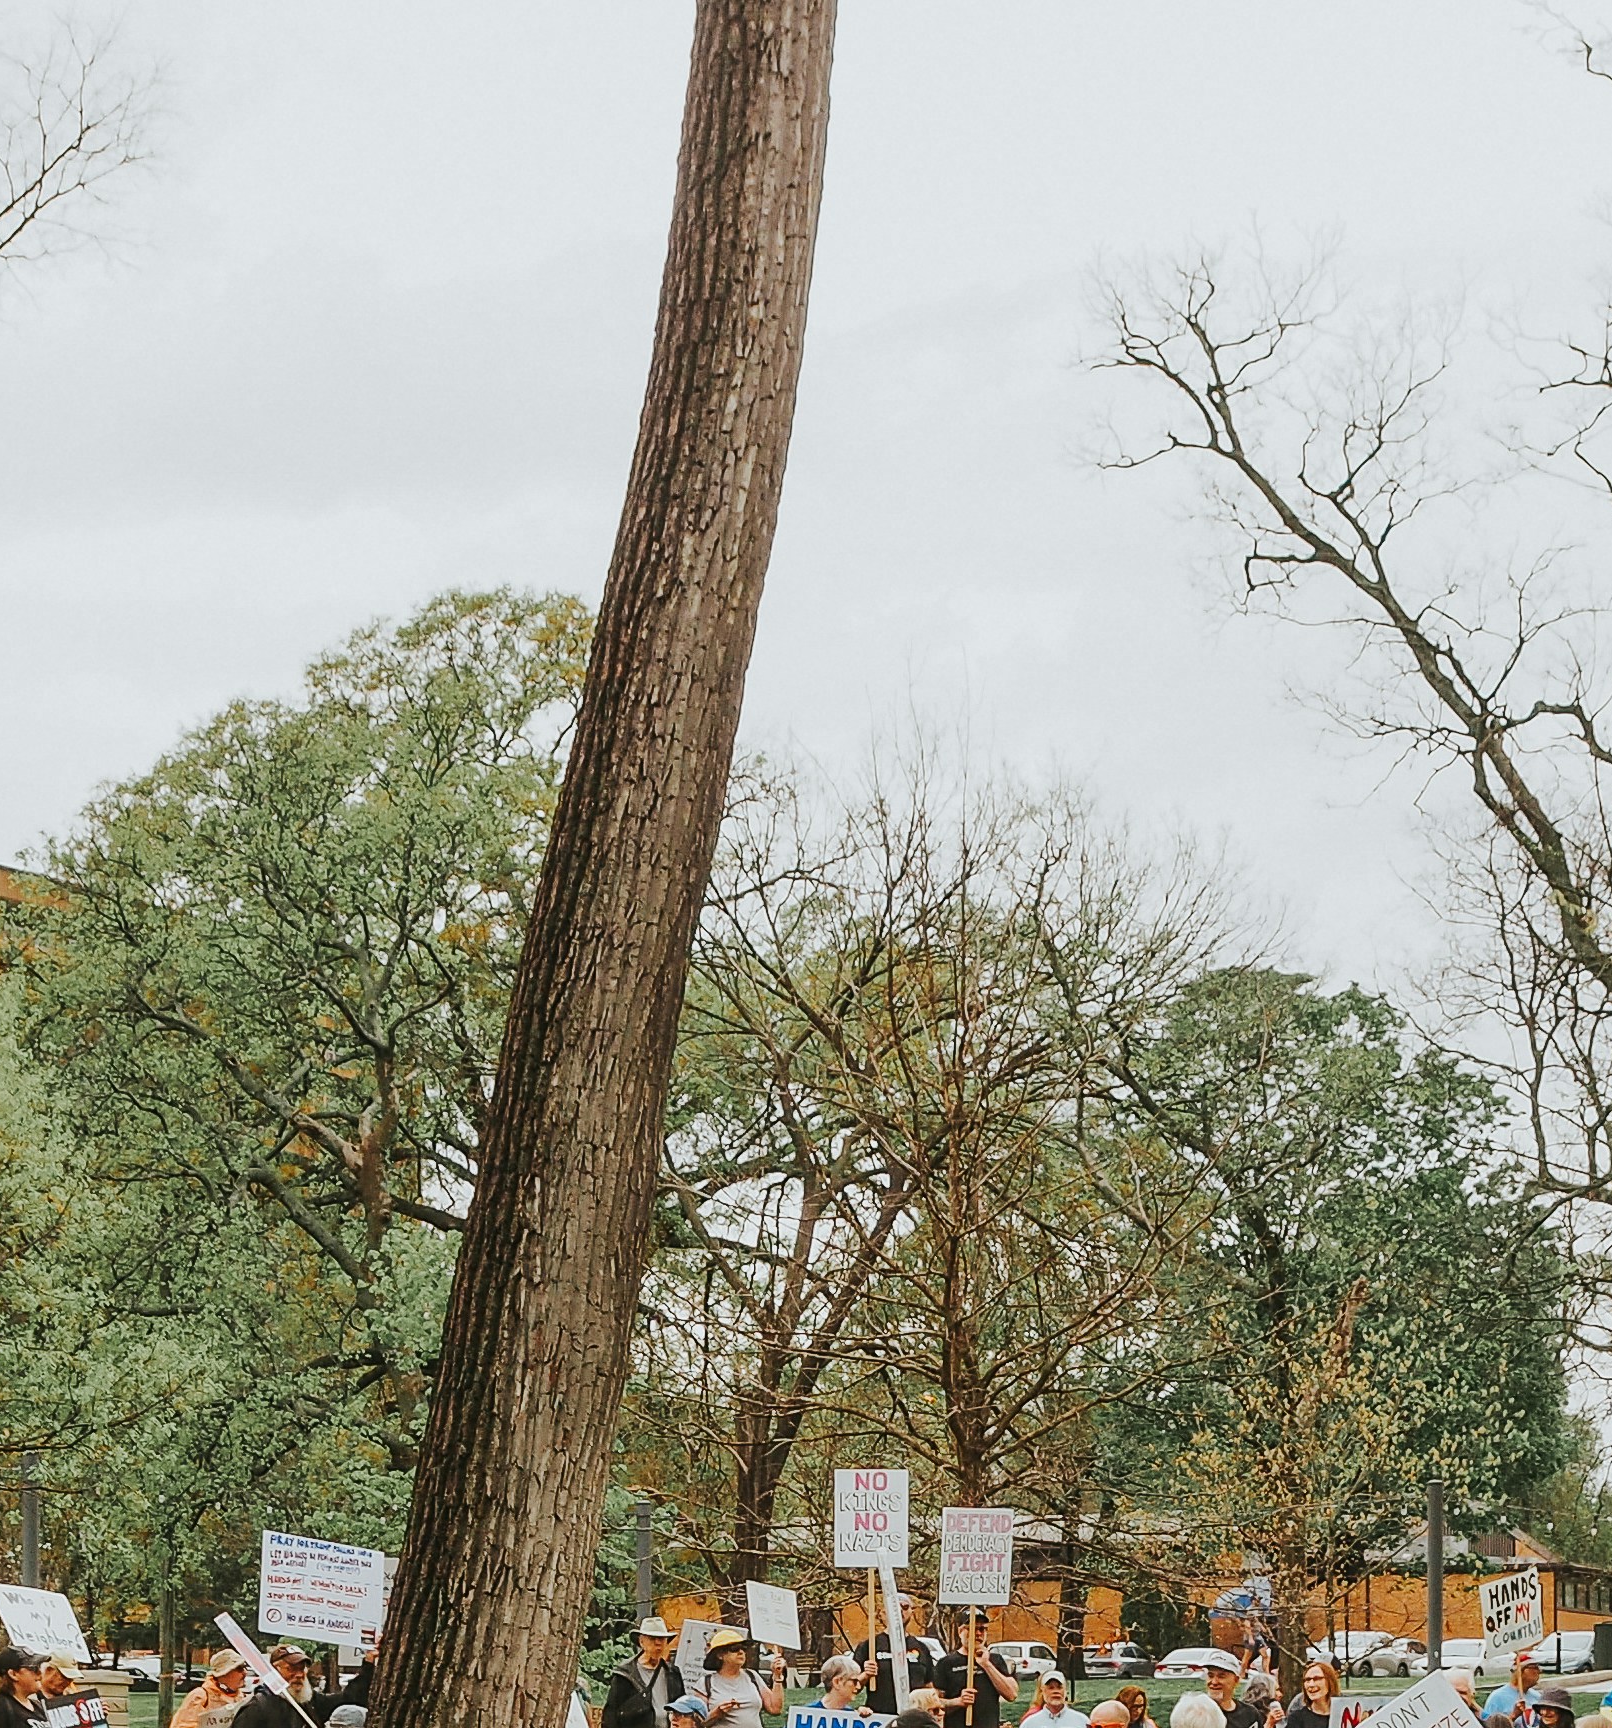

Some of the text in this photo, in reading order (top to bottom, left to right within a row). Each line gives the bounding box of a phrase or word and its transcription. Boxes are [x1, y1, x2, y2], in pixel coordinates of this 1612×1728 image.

[854, 1471, 888, 1491] NO
[839, 1492, 901, 1512] KINGS
[854, 1512, 888, 1532] NO
[946, 1513, 1013, 1533] DEFEND
[839, 1532, 903, 1552] NAZIS
[944, 1533, 1012, 1553] DEMOCRACY
[947, 1553, 1006, 1573] FIGHT
[942, 1573, 1009, 1594] FASCISM
[1488, 1573, 1537, 1609] HANDS
[1485, 1601, 1530, 1632] OFF MY
[10, 1622, 83, 1650] Neighbor?
